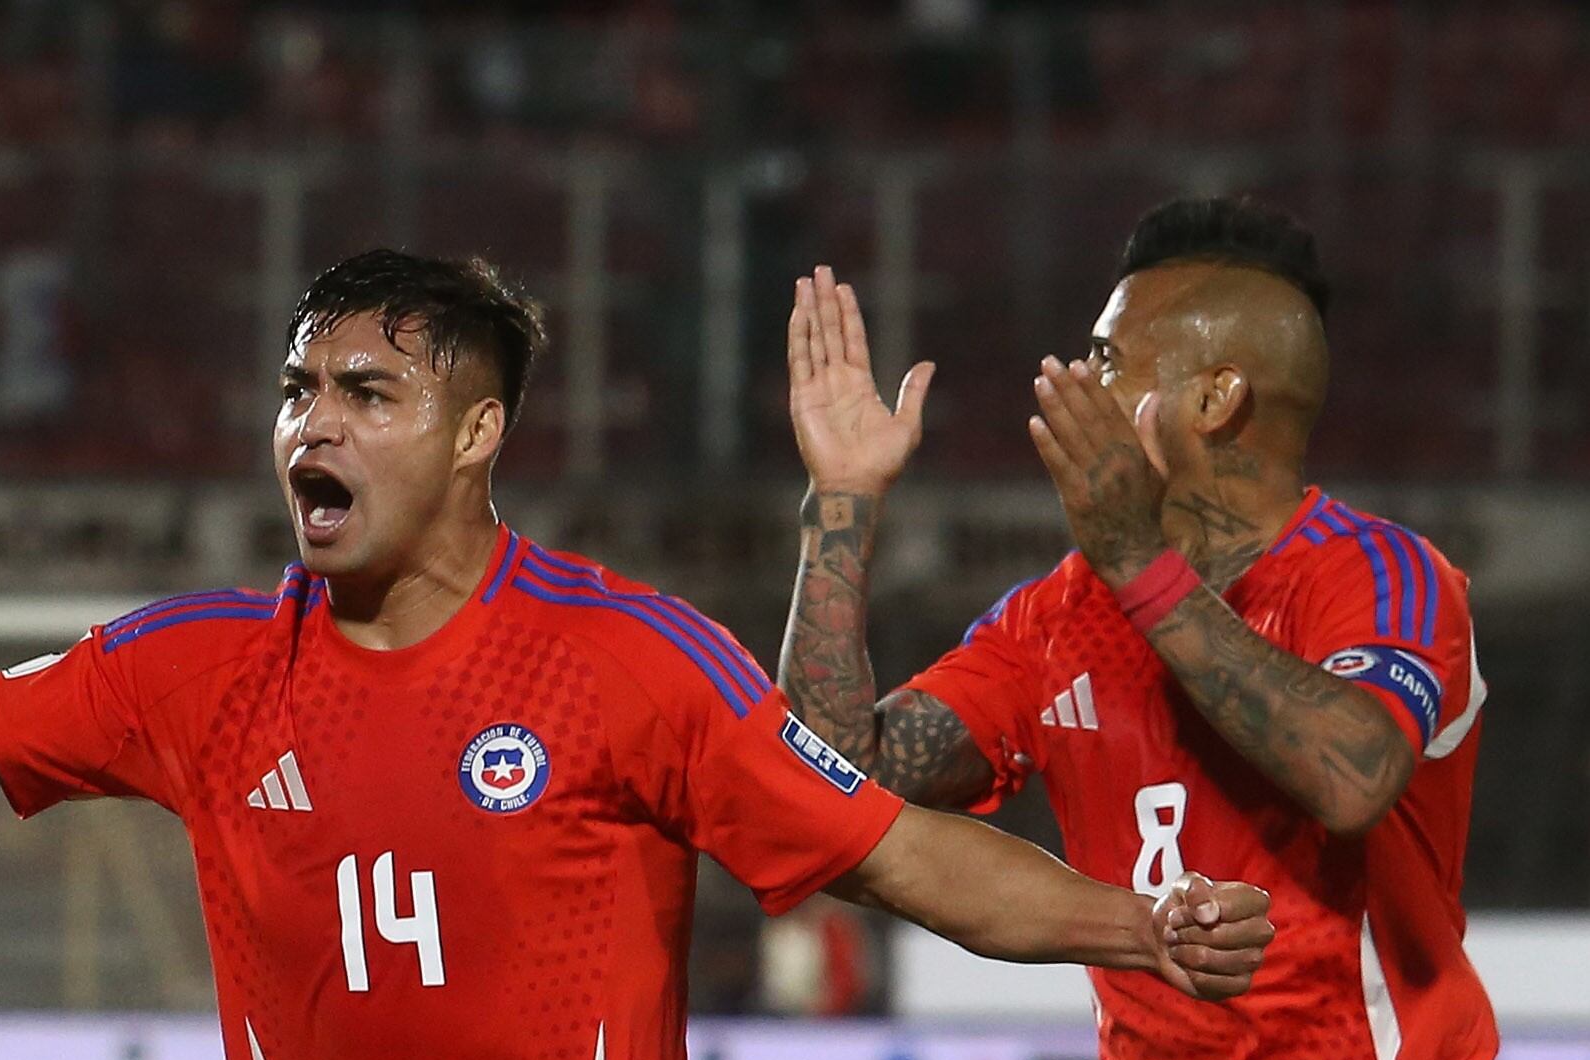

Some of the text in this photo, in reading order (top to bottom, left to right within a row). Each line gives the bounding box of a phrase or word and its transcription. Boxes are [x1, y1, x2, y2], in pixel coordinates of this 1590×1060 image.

[509, 726, 522, 739] DE
[481, 794, 528, 811] DE CHILE
[1133, 782, 1187, 900] 8
[337, 851, 445, 992] 14
